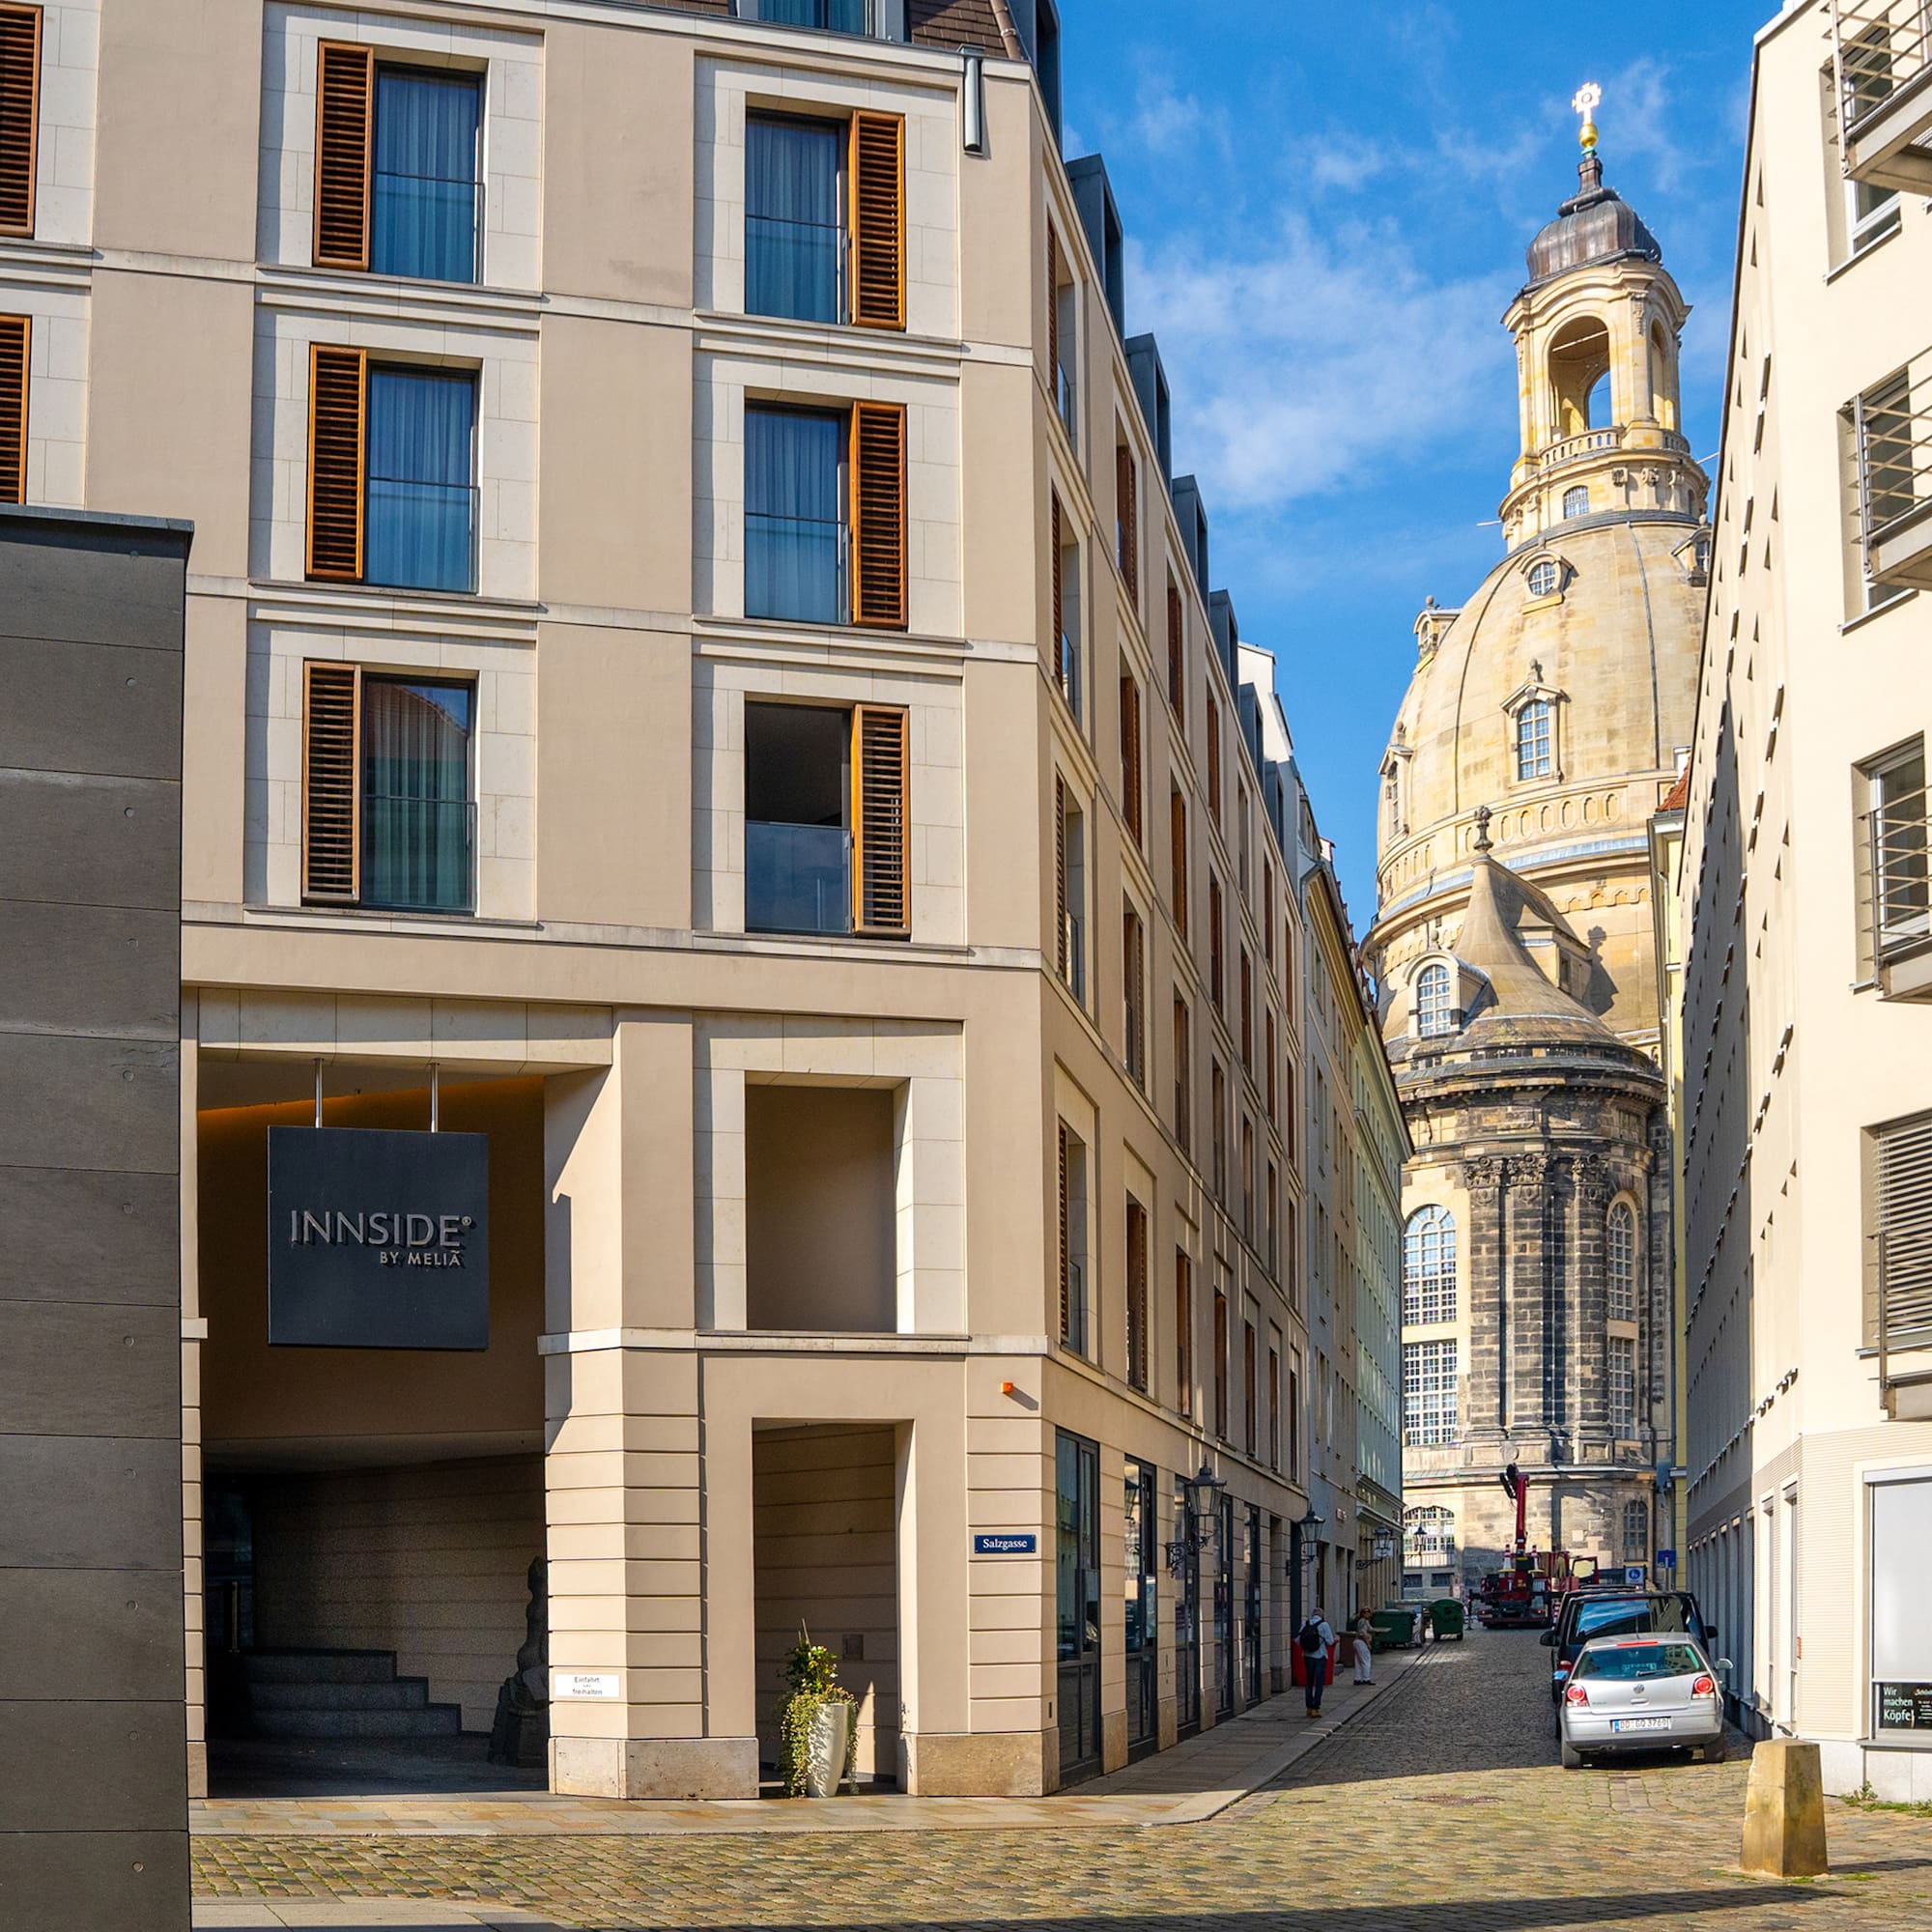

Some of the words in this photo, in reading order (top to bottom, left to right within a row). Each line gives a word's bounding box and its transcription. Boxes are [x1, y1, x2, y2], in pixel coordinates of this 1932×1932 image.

[380, 1251, 400, 1264] BY
[982, 1538, 1028, 1551] Salzgasse
[1883, 1686, 1897, 1696] Wir
[1883, 1696, 1914, 1707] machen
